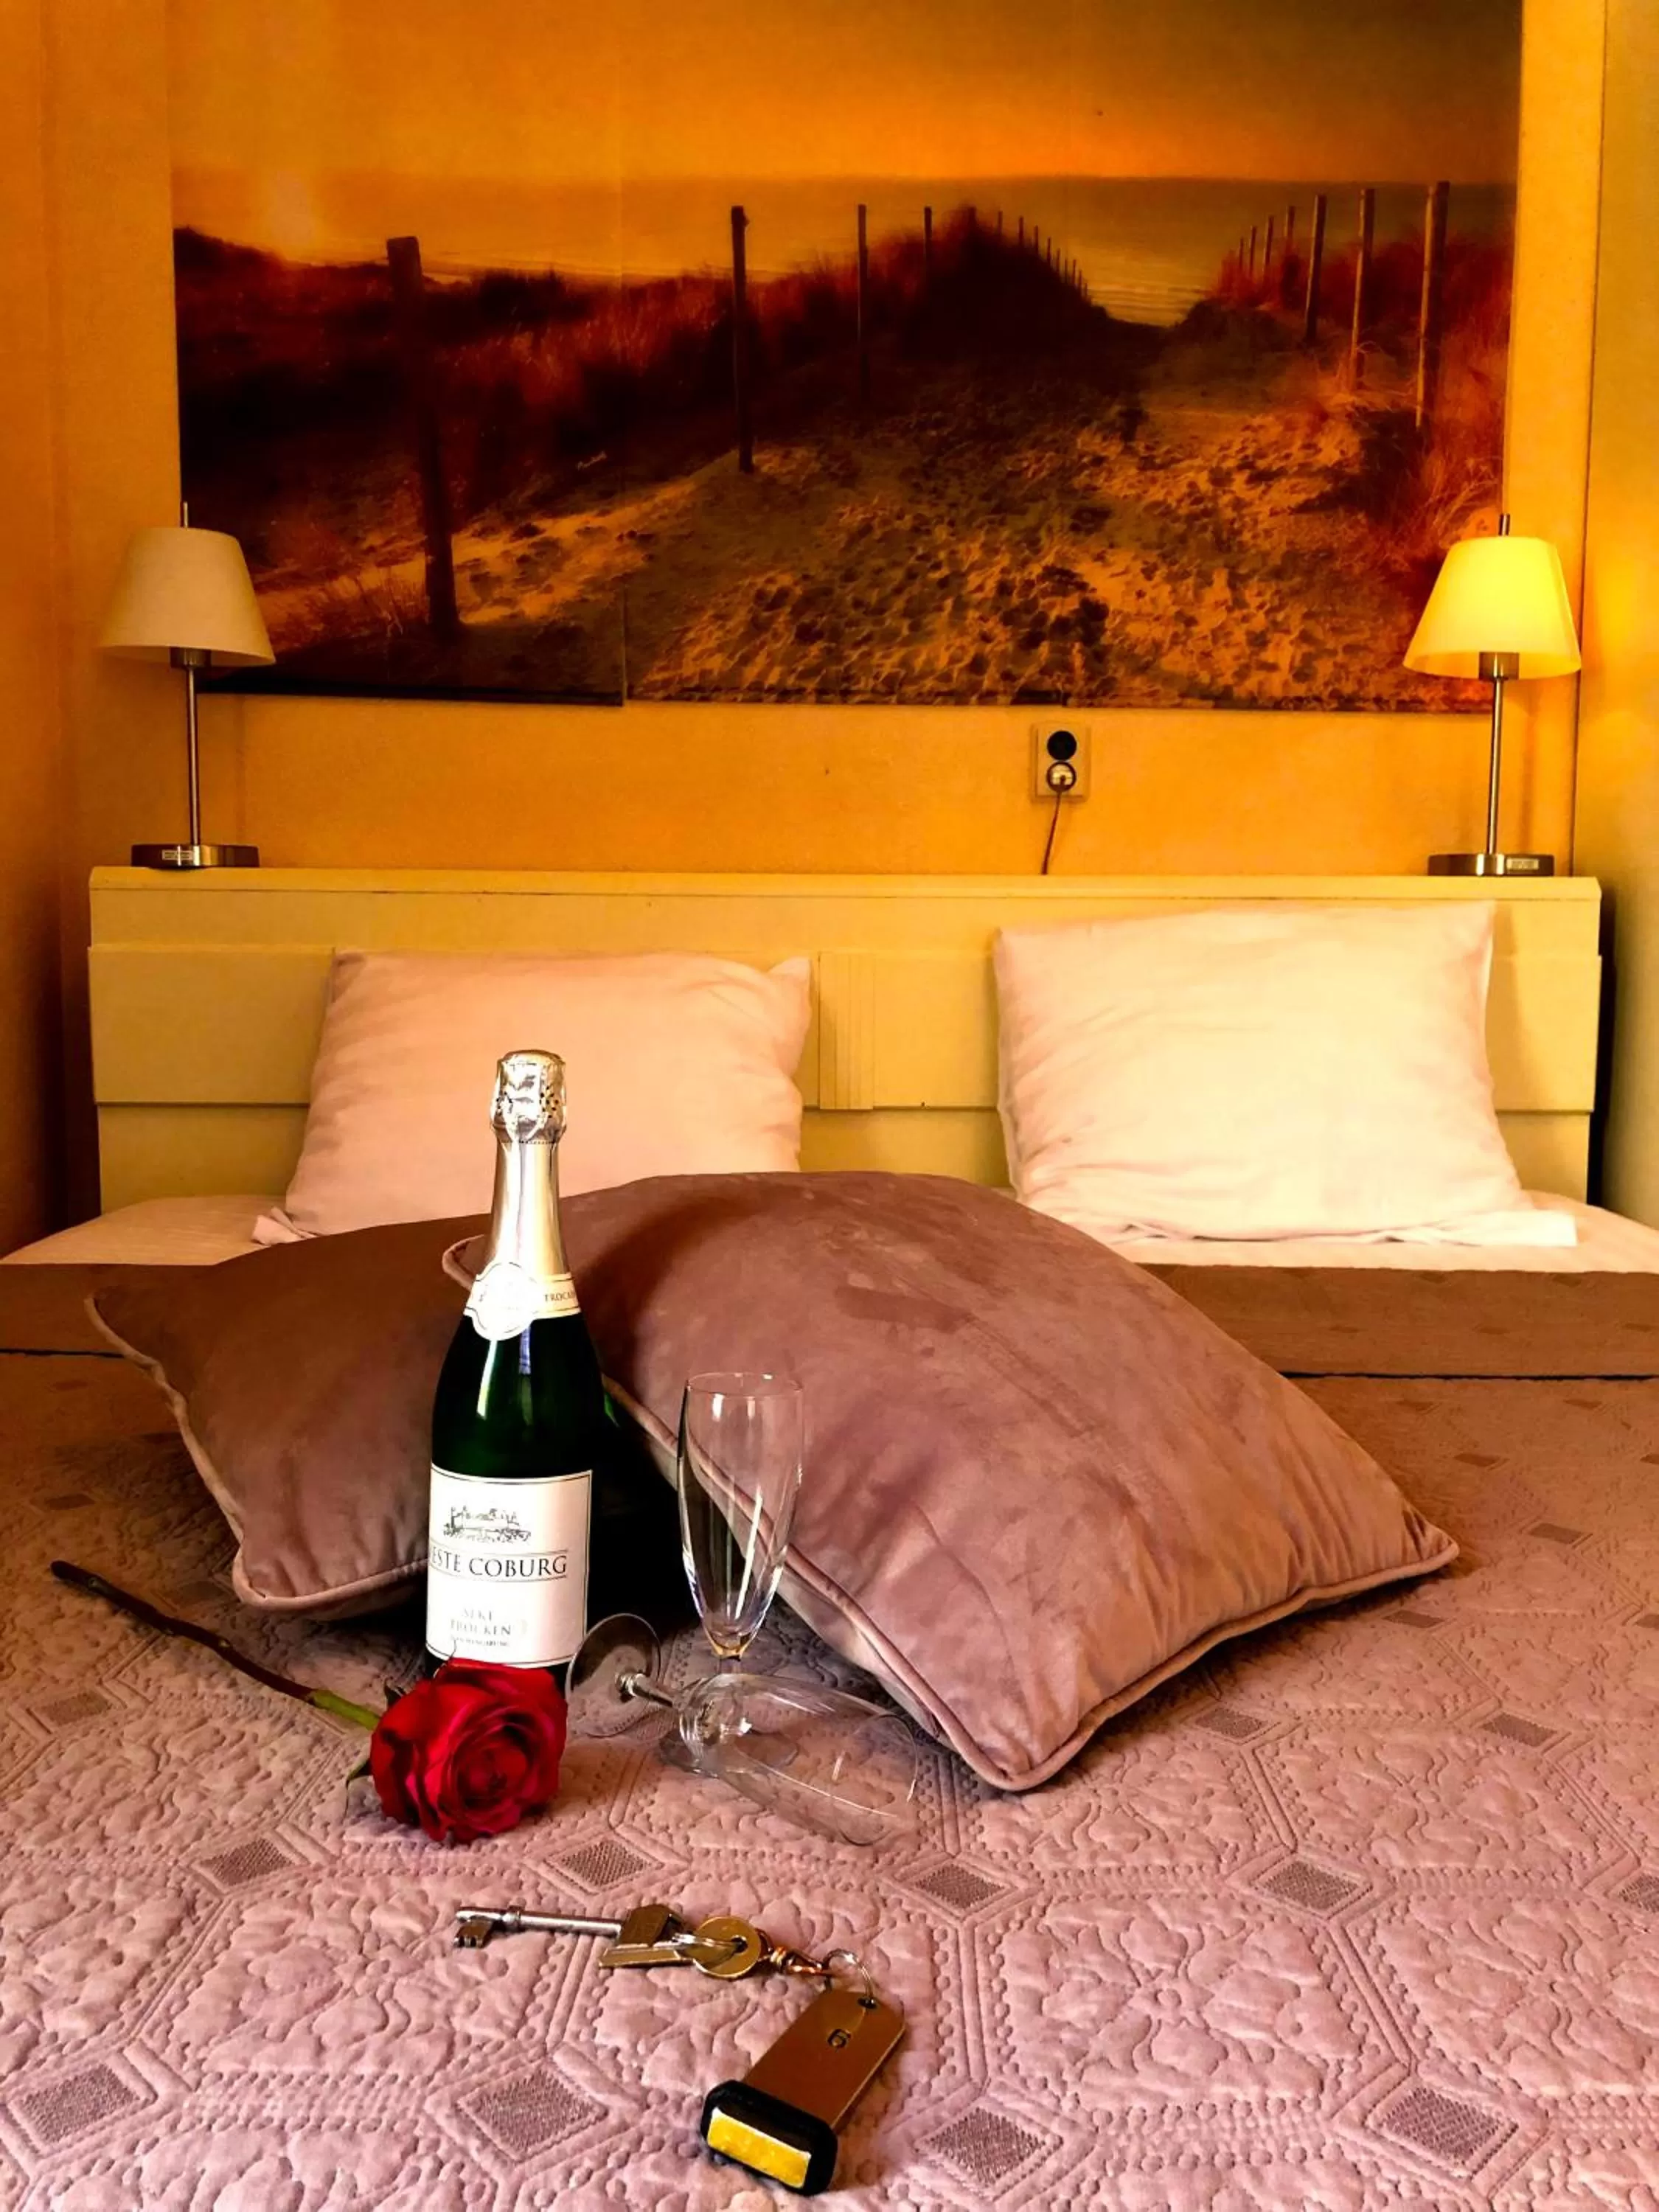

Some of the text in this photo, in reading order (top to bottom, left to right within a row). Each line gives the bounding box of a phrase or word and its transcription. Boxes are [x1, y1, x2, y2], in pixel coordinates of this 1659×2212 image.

[430, 1545, 567, 1578] ESTE COBURG
[827, 2028, 852, 2049] 6
